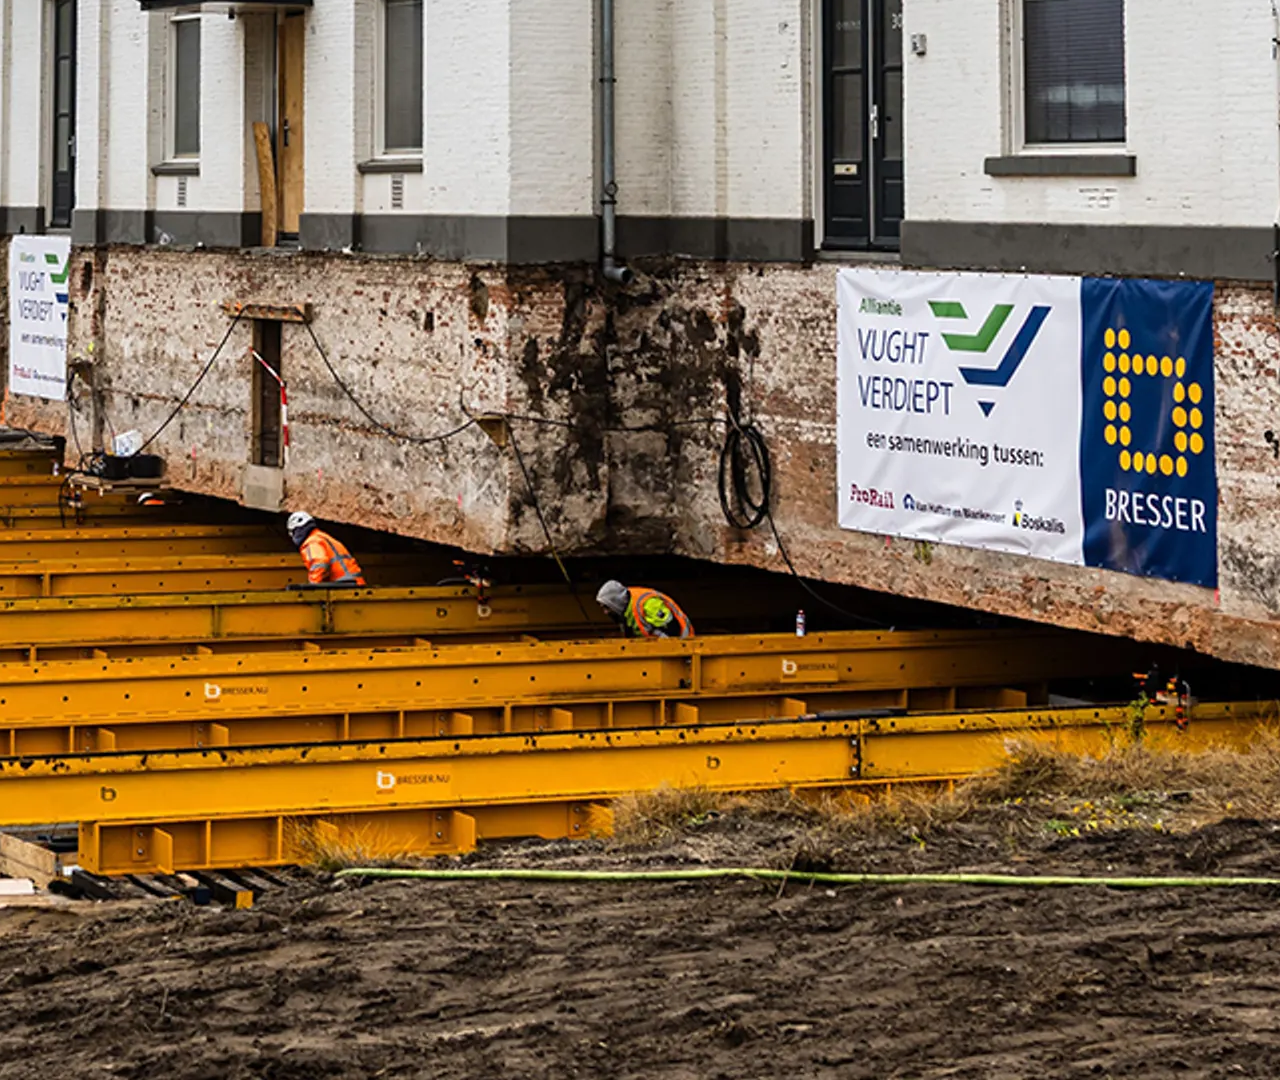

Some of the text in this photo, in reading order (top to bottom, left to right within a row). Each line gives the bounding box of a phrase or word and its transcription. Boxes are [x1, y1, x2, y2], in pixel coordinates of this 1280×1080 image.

[859, 298, 902, 316] Alliantie
[858, 328, 930, 364] VUGHT
[858, 375, 954, 415] VERDIEPT
[867, 432, 1044, 467] een samenwerking tussen:
[850, 484, 895, 509] ProRail
[1104, 488, 1207, 533] BRESSER
[1021, 513, 1066, 534] Boskalis
